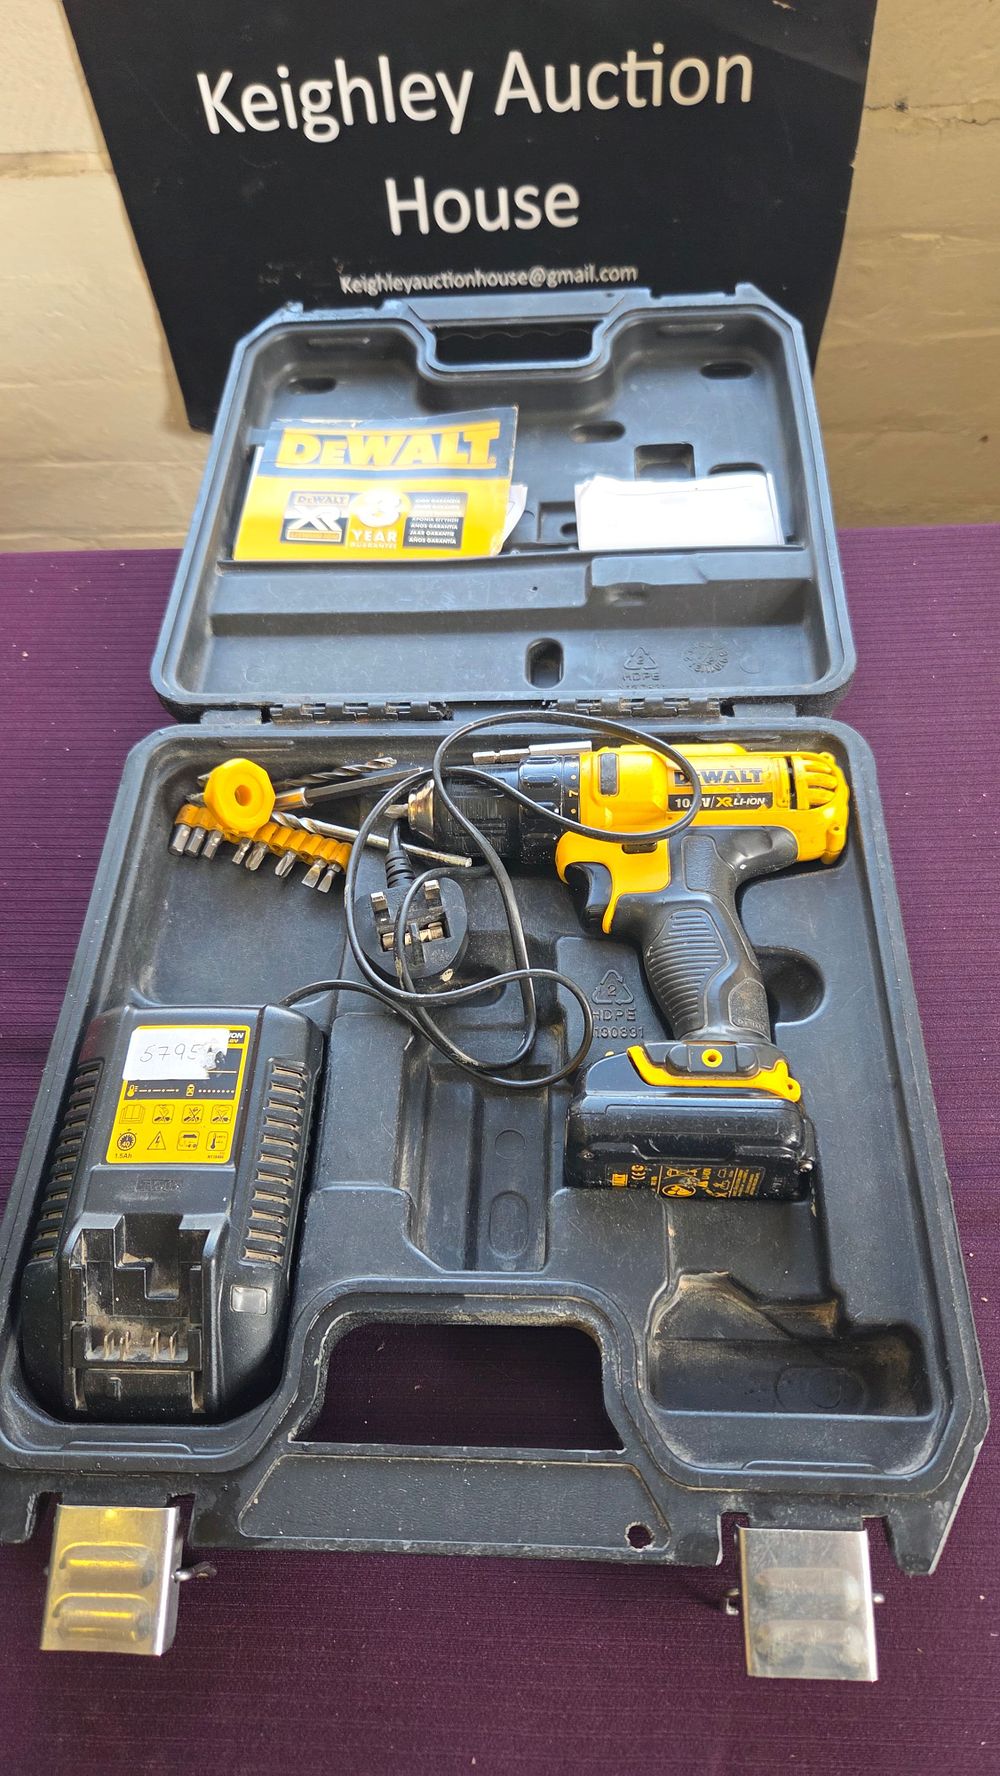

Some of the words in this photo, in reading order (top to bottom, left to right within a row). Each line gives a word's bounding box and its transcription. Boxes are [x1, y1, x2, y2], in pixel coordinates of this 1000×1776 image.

[197, 54, 474, 143] Keighley
[494, 43, 754, 116] Auction
[384, 176, 580, 236] House
[340, 264, 638, 295] Keighleyauctionhouse@gmail.com
[352, 530, 397, 543] YEAR
[674, 769, 762, 785] DWALT
